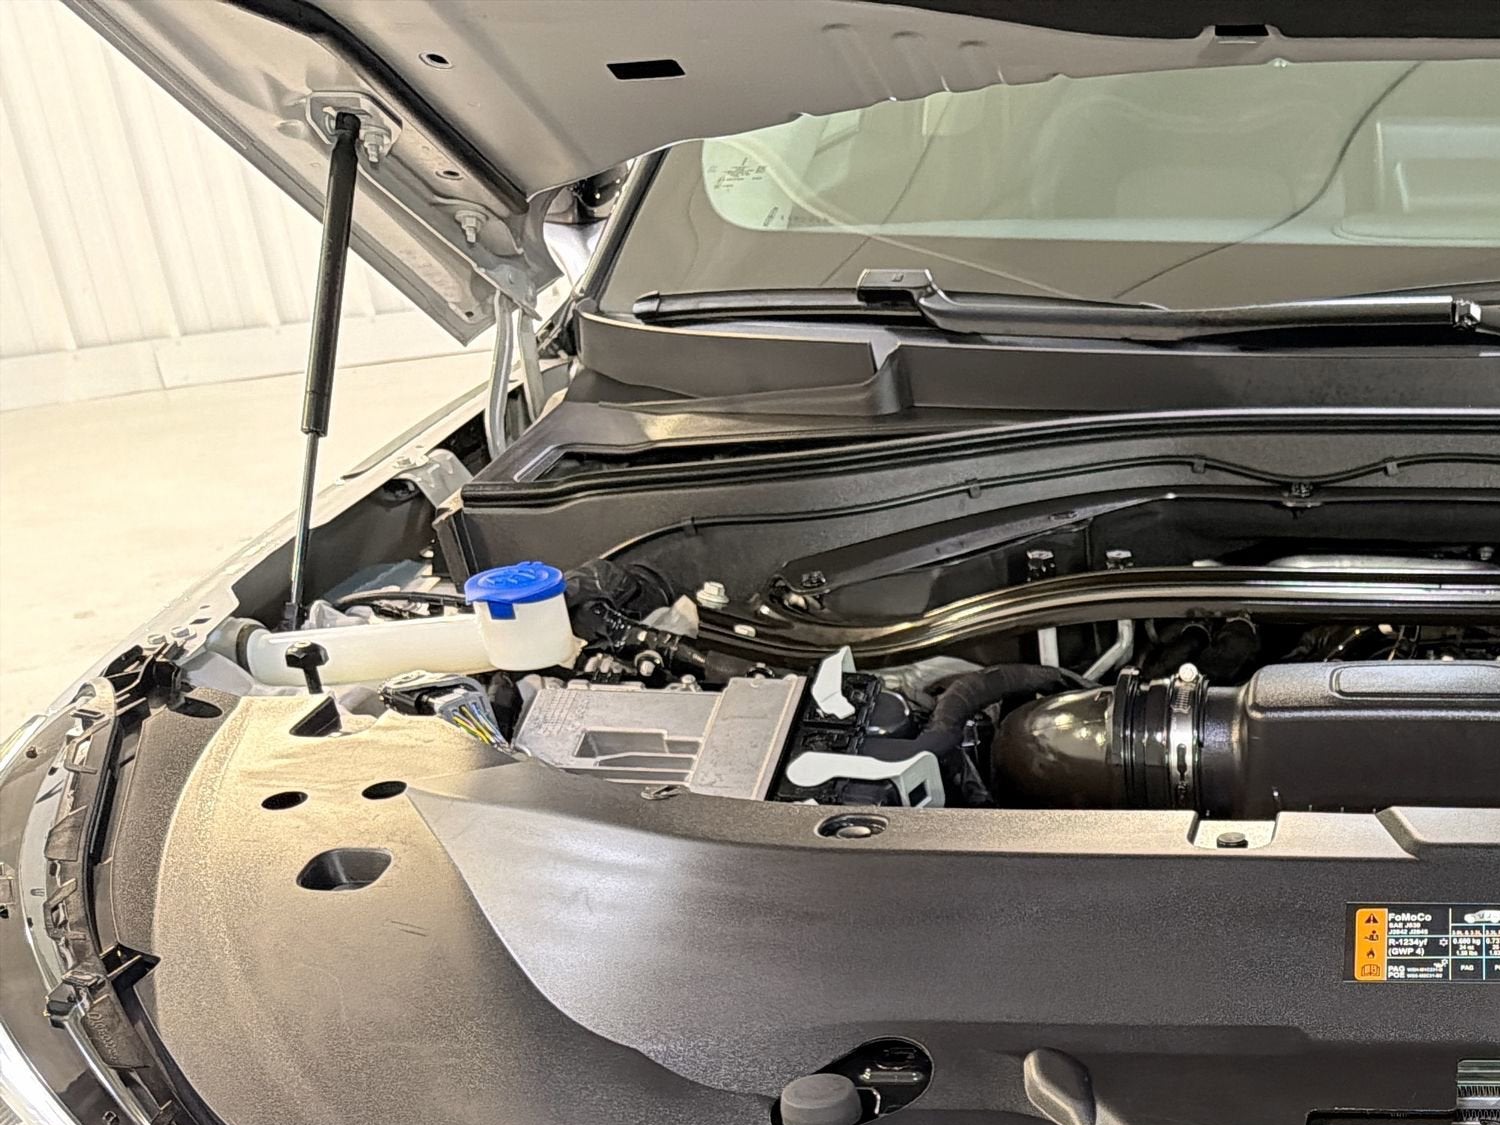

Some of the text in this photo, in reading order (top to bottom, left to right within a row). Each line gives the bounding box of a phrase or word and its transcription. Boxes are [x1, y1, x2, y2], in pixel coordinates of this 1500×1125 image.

[1388, 913, 1432, 921] FoMoCo
[1388, 938, 1428, 947] R-1234yf
[1472, 938, 1481, 946] kg
[1388, 947, 1425, 956] (GWP 4)
